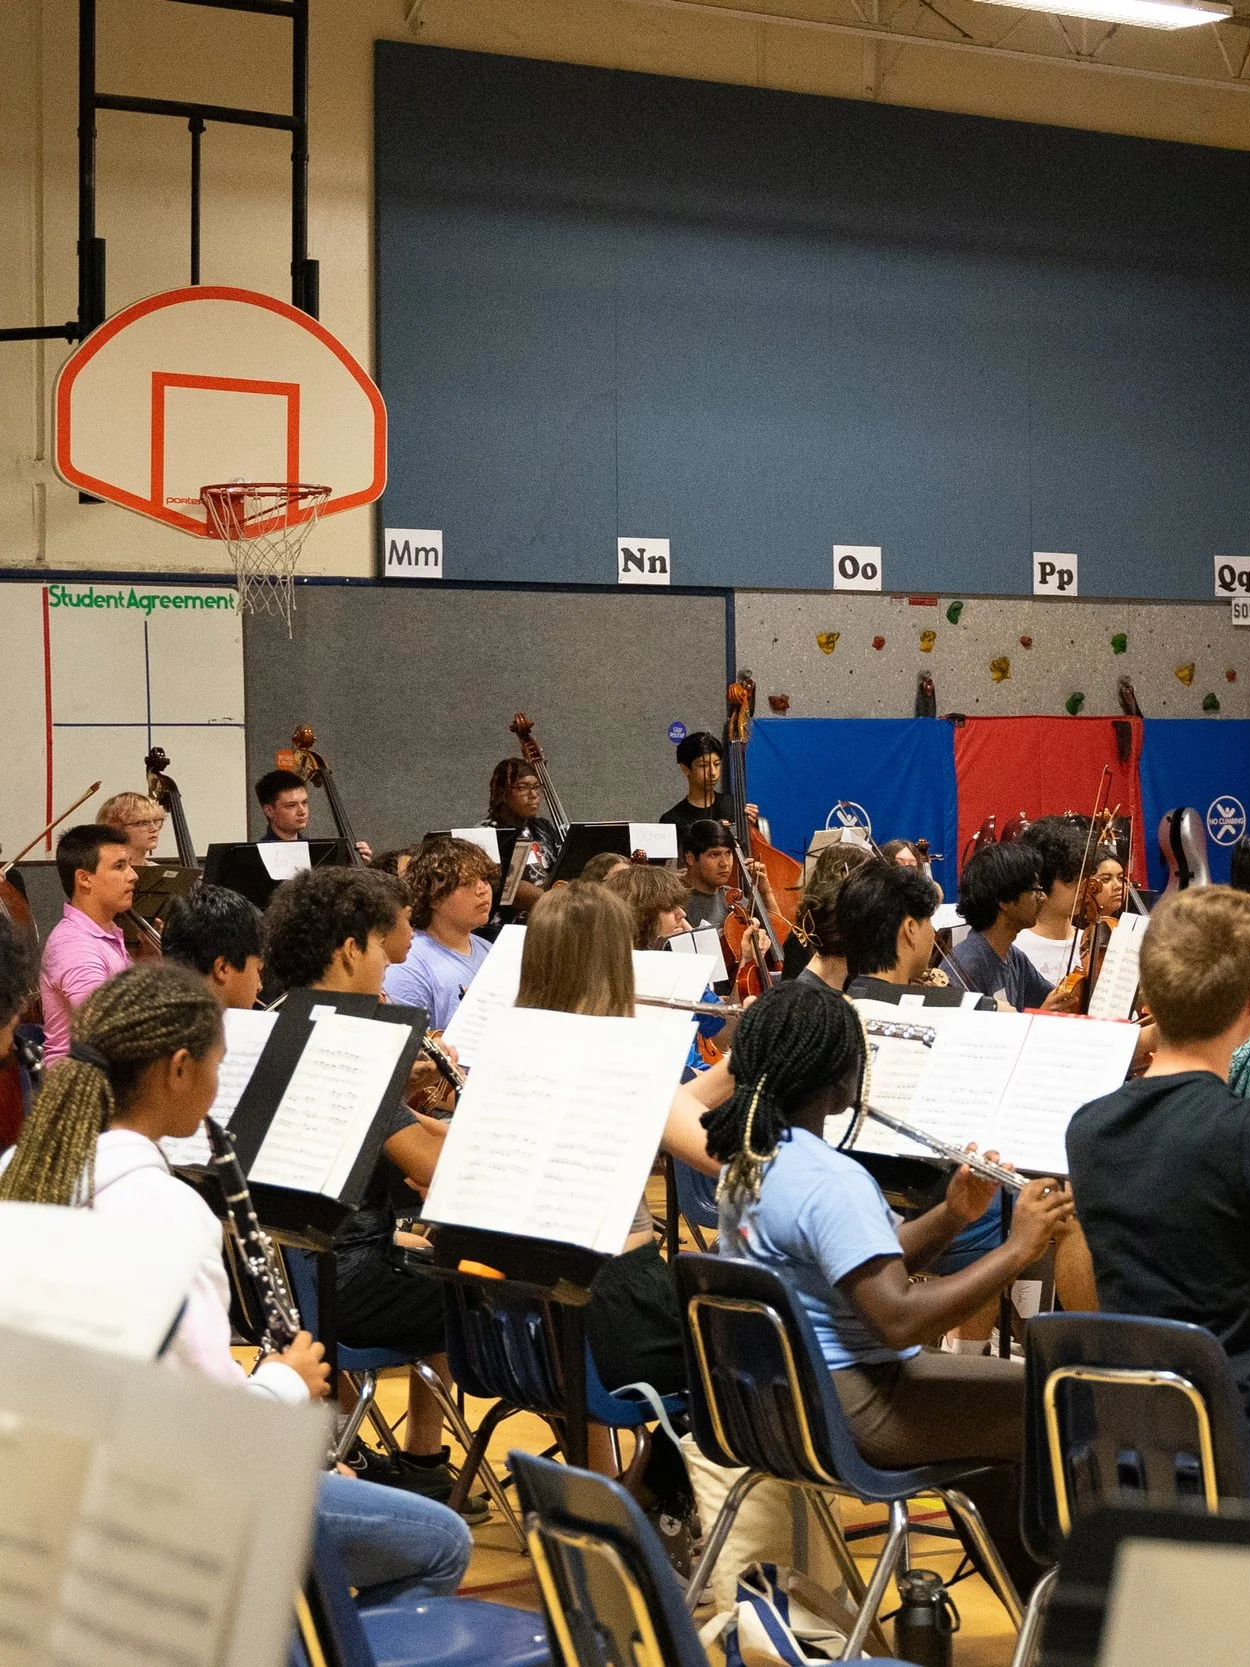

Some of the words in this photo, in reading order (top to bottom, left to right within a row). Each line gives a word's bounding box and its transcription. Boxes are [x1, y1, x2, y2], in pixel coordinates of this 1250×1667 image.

[388, 539, 439, 566] Mm
[620, 547, 668, 574] Nn
[838, 555, 878, 580] Oo
[1038, 561, 1074, 591] Pp
